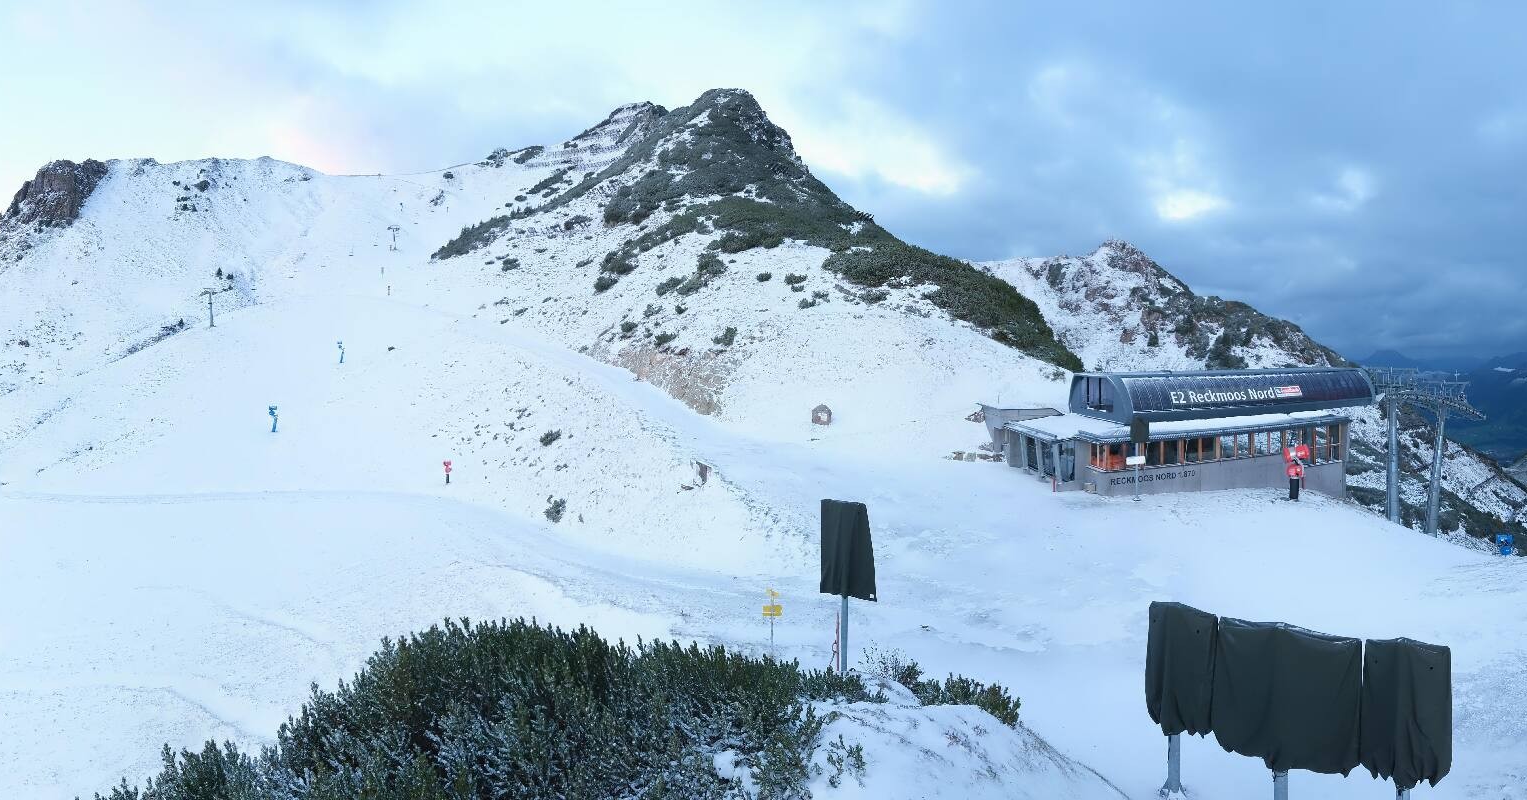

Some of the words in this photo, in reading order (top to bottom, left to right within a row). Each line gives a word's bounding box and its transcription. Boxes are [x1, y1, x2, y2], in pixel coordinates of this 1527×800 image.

[1170, 391, 1187, 404] E2
[1188, 389, 1247, 403] Reckmoos
[1248, 386, 1276, 400] Nord
[1155, 473, 1177, 482] NORD
